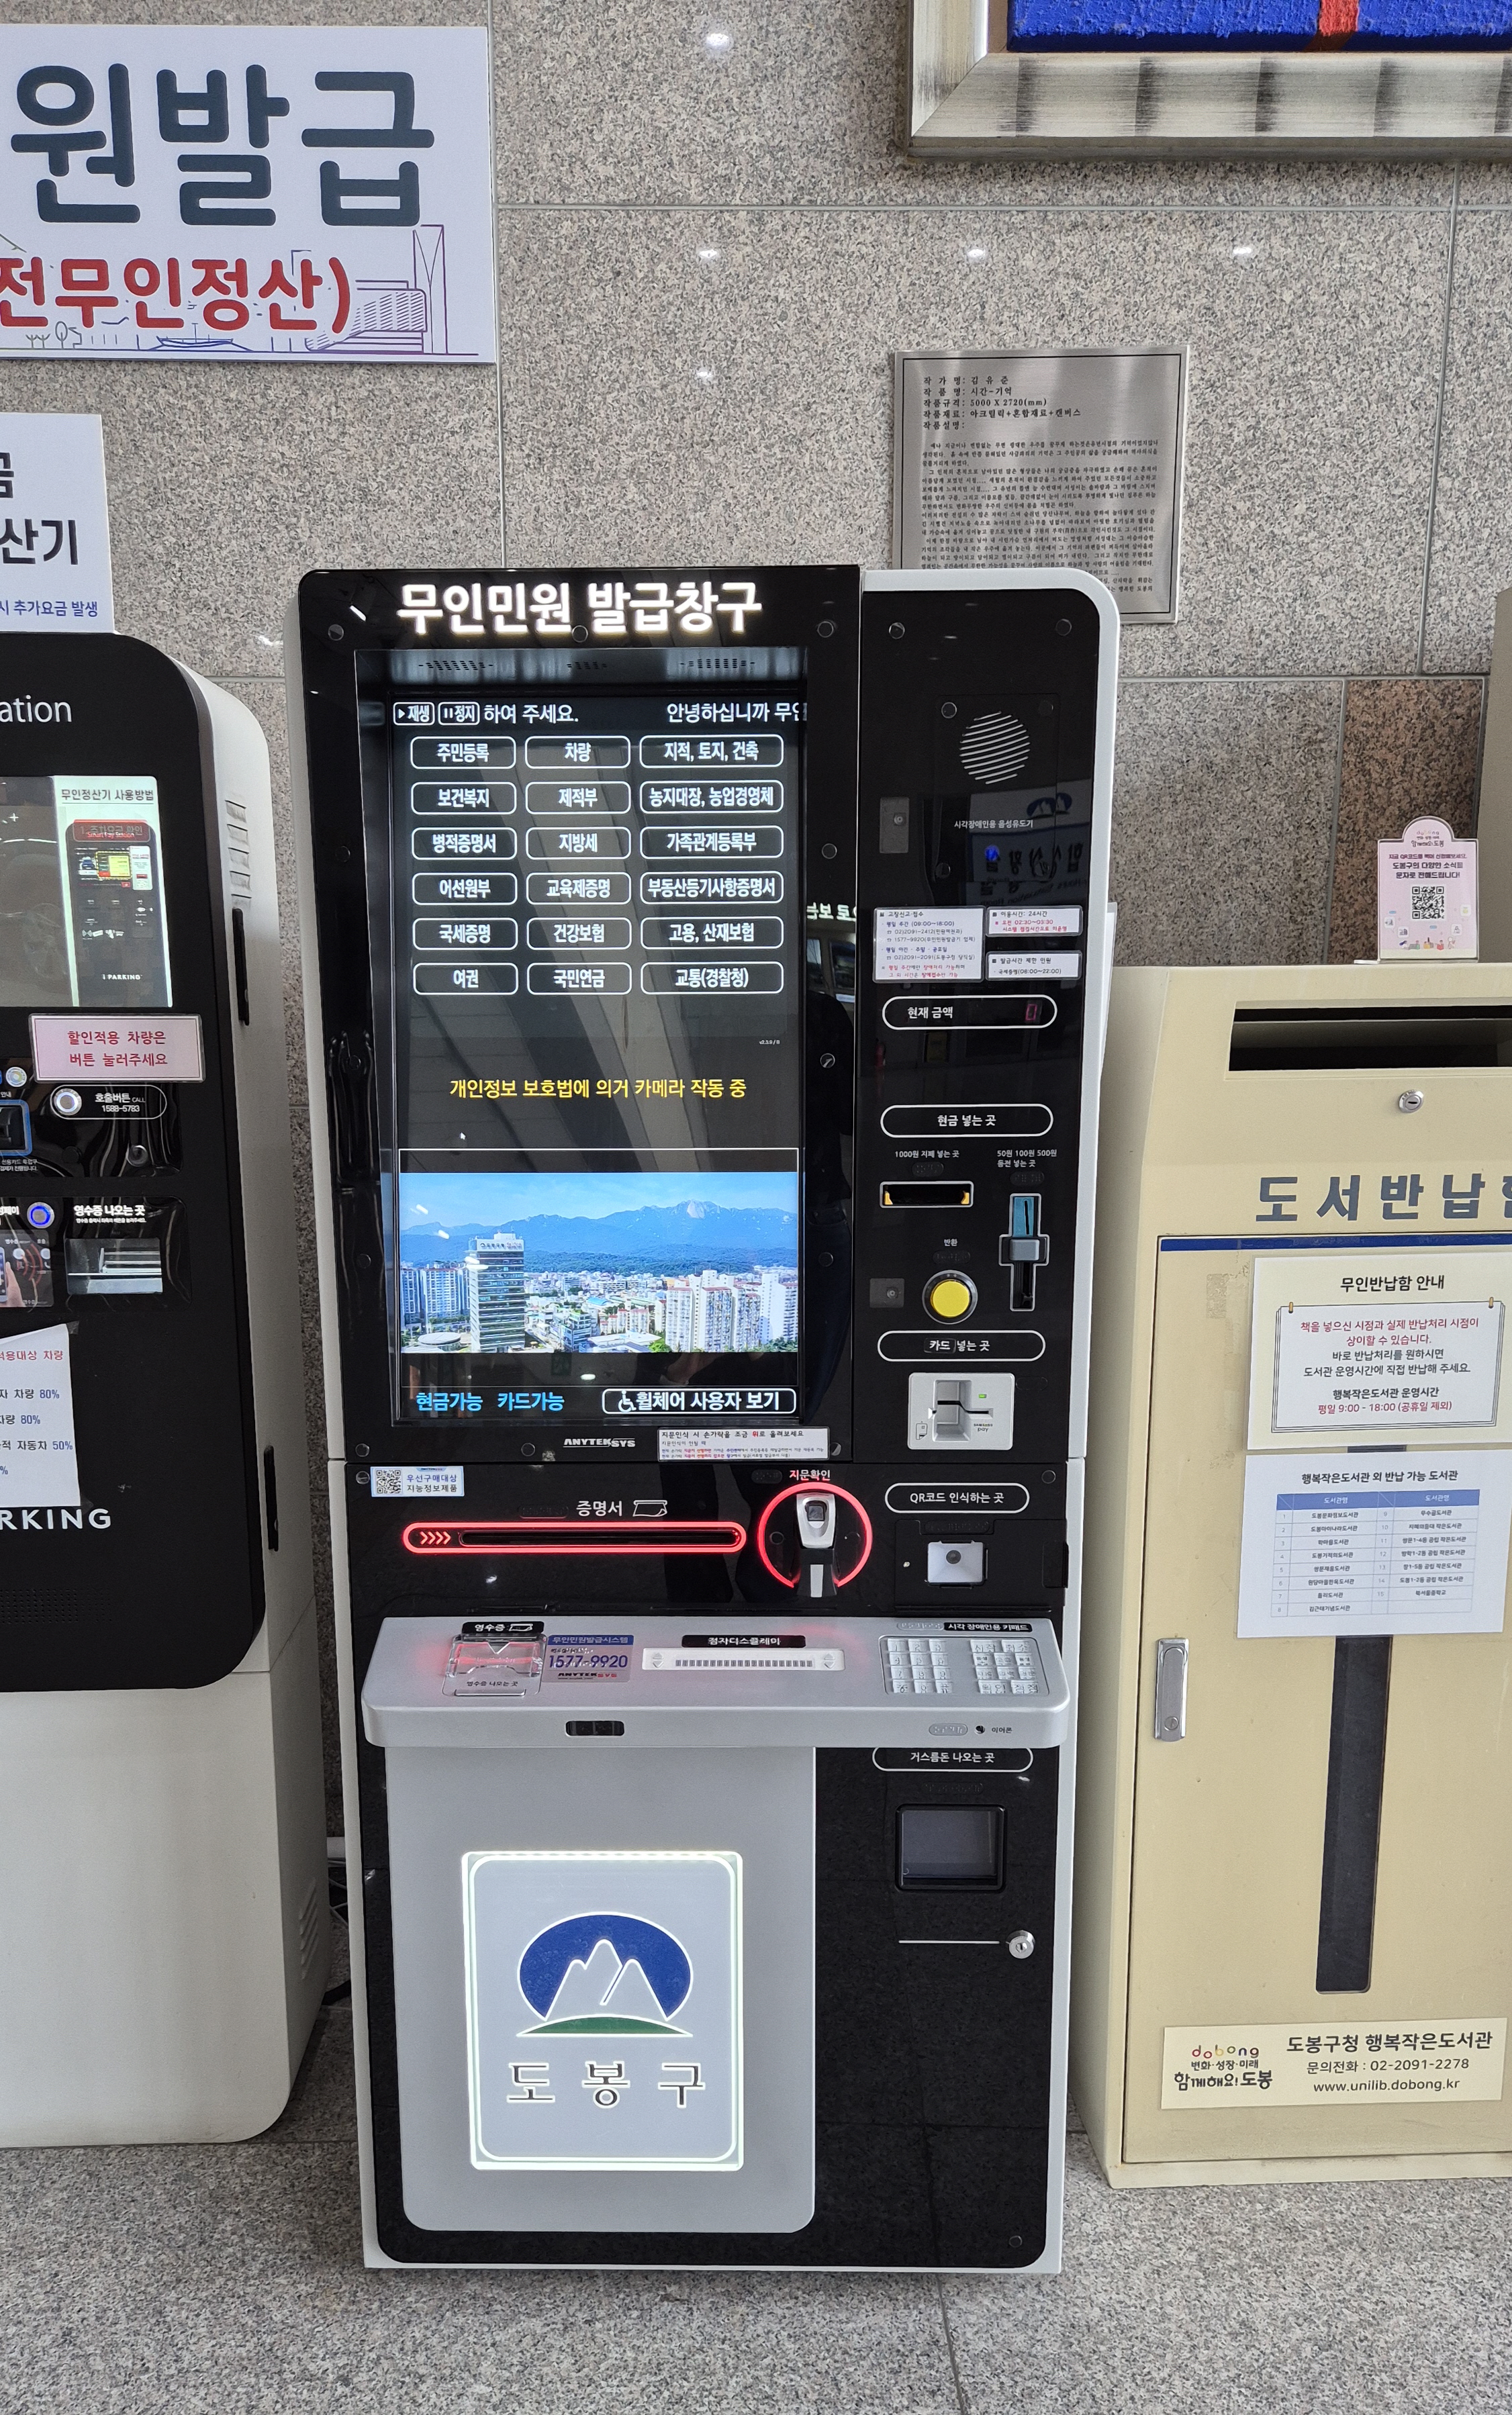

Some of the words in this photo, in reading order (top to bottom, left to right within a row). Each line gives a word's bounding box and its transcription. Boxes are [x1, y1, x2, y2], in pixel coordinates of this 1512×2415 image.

[11, 63, 434, 226] 원발급
[1003, 397, 1047, 407] 2720(mm)
[13, 600, 67, 616] 추가요금
[72, 600, 98, 617] 발생
[397, 582, 572, 634] 무인민원
[587, 581, 762, 633] 발급창구
[0, 695, 72, 722] ation
[408, 705, 430, 722] 재생
[454, 705, 475, 722] 정지
[483, 704, 516, 724] 하여
[667, 702, 769, 723] 안녕하십니까
[437, 743, 489, 763] 주민등록
[565, 742, 591, 762] 차량
[664, 741, 694, 762] 지적,
[698, 741, 728, 762] 토지,
[732, 741, 759, 761] 건축
[61, 789, 111, 800] 무인정산기
[115, 789, 154, 801] 사용방법
[438, 788, 489, 808] 보건복지
[558, 788, 598, 807] 제적부
[649, 787, 705, 808] 농지대장,
[708, 786, 773, 807] 농업경영체
[432, 833, 496, 853] 병적증명서
[559, 833, 598, 853] 지방세
[667, 832, 757, 852] 가족관계등록부
[439, 879, 491, 898] 어선원부
[546, 878, 610, 898] 교육제증명
[648, 877, 775, 898] 부동산등기사항증명서
[439, 924, 491, 943] 국세증명
[553, 923, 605, 943] 건강보험
[669, 922, 699, 943] 고용,
[703, 922, 754, 943] 산재보험
[453, 969, 479, 988] 여권
[553, 969, 605, 988] 국민연금
[675, 967, 749, 988] 교통(경찰청)
[908, 1006, 929, 1019] 현재
[931, 1006, 953, 1019] 금액
[68, 1031, 120, 1045] 할인적용
[128, 1031, 167, 1045] 차량은
[70, 1053, 95, 1066] 버튼
[103, 1053, 168, 1067] 눌러주세요
[450, 1079, 518, 1099] 개인정보
[522, 1079, 590, 1098] 보호법에
[596, 1079, 629, 1098] 의거
[634, 1078, 685, 1098] 카메라
[690, 1078, 724, 1098] 작동
[728, 1079, 747, 1098] 중
[95, 1092, 131, 1103] 호출버튼
[101, 1104, 140, 1112] 1588-5783
[937, 1115, 958, 1127] 현금
[962, 1115, 982, 1126] 넣는
[985, 1115, 996, 1126] 곳
[895, 1150, 919, 1158] 1000원
[1037, 1149, 1057, 1157] 500원
[1256, 1172, 1512, 1222] 도서반납
[74, 1204, 102, 1217] 영수증
[104, 1204, 133, 1217] 나오는
[1340, 1276, 1413, 1293] 무인반납함
[1416, 1274, 1445, 1290] 안내
[1323, 1320, 1352, 1332] 넣으신
[1354, 1319, 1384, 1331] 시점과
[1386, 1319, 1405, 1331] 실제
[1409, 1318, 1447, 1329] 반납처리
[1450, 1317, 1479, 1329] 시점이
[929, 1340, 951, 1352] 카드
[956, 1340, 976, 1352] 넣는
[1346, 1334, 1376, 1347] 상이할
[1390, 1334, 1431, 1345] 있습니다.
[44, 1350, 64, 1361] 차량
[1332, 1351, 1352, 1362] 바로
[1354, 1349, 1403, 1361] 반납처리를
[1405, 1348, 1444, 1360] 원하시면
[1303, 1366, 1333, 1378] 도서관
[1335, 1365, 1383, 1377] 운영시간에
[1386, 1364, 1405, 1376] 직접
[1408, 1364, 1437, 1376] 반납해
[14, 1389, 34, 1399] 차량
[40, 1389, 60, 1399] 80%
[416, 1392, 483, 1412] 현금가능
[498, 1392, 565, 1411] 카드가능
[636, 1391, 686, 1411] 휠체어
[690, 1391, 742, 1411] 사용자
[746, 1390, 779, 1411] 보기
[1333, 1388, 1399, 1401] 행복작은도서관
[1401, 1387, 1439, 1399] 운영시간
[1317, 1404, 1335, 1415] 평일
[1338, 1403, 1360, 1413] 9:00
[1368, 1403, 1396, 1412] 18:00
[1398, 1401, 1428, 1413] (공휴일
[20, 1415, 40, 1425] 80%
[17, 1441, 47, 1450] 자동차
[53, 1441, 73, 1450] 50%
[563, 1437, 636, 1448] ANYTEKSYS
[407, 1474, 457, 1483] 우선구매대상
[790, 1469, 831, 1481] 지문확인
[1301, 1472, 1370, 1484] 행복작은도서관
[1384, 1471, 1404, 1483] 반납
[1407, 1471, 1426, 1481] 가능
[1429, 1470, 1458, 1481] 도서관
[407, 1484, 457, 1493] 지능정보제품
[910, 1493, 946, 1503] QR코드
[949, 1492, 991, 1503] 인식하는
[576, 1501, 622, 1517] 증명서
[475, 1623, 505, 1631] 영수증
[549, 1655, 628, 1668] 1577-9920
[910, 1752, 949, 1763] 거스름돈
[953, 1752, 982, 1763] 나오는
[1286, 2034, 1358, 2054] 도봉구청
[1365, 2032, 1494, 2052] 행복작은도서관
[1192, 2045, 1259, 2058] dobong
[1307, 2061, 1358, 2075] 문의전화
[1370, 2058, 1469, 2071] 02-2091-2278
[1174, 2071, 1238, 2091] 함께해요!
[1239, 2070, 1273, 2090] 도봉
[1313, 2079, 1460, 2093] www.unilib.dobong.kr
